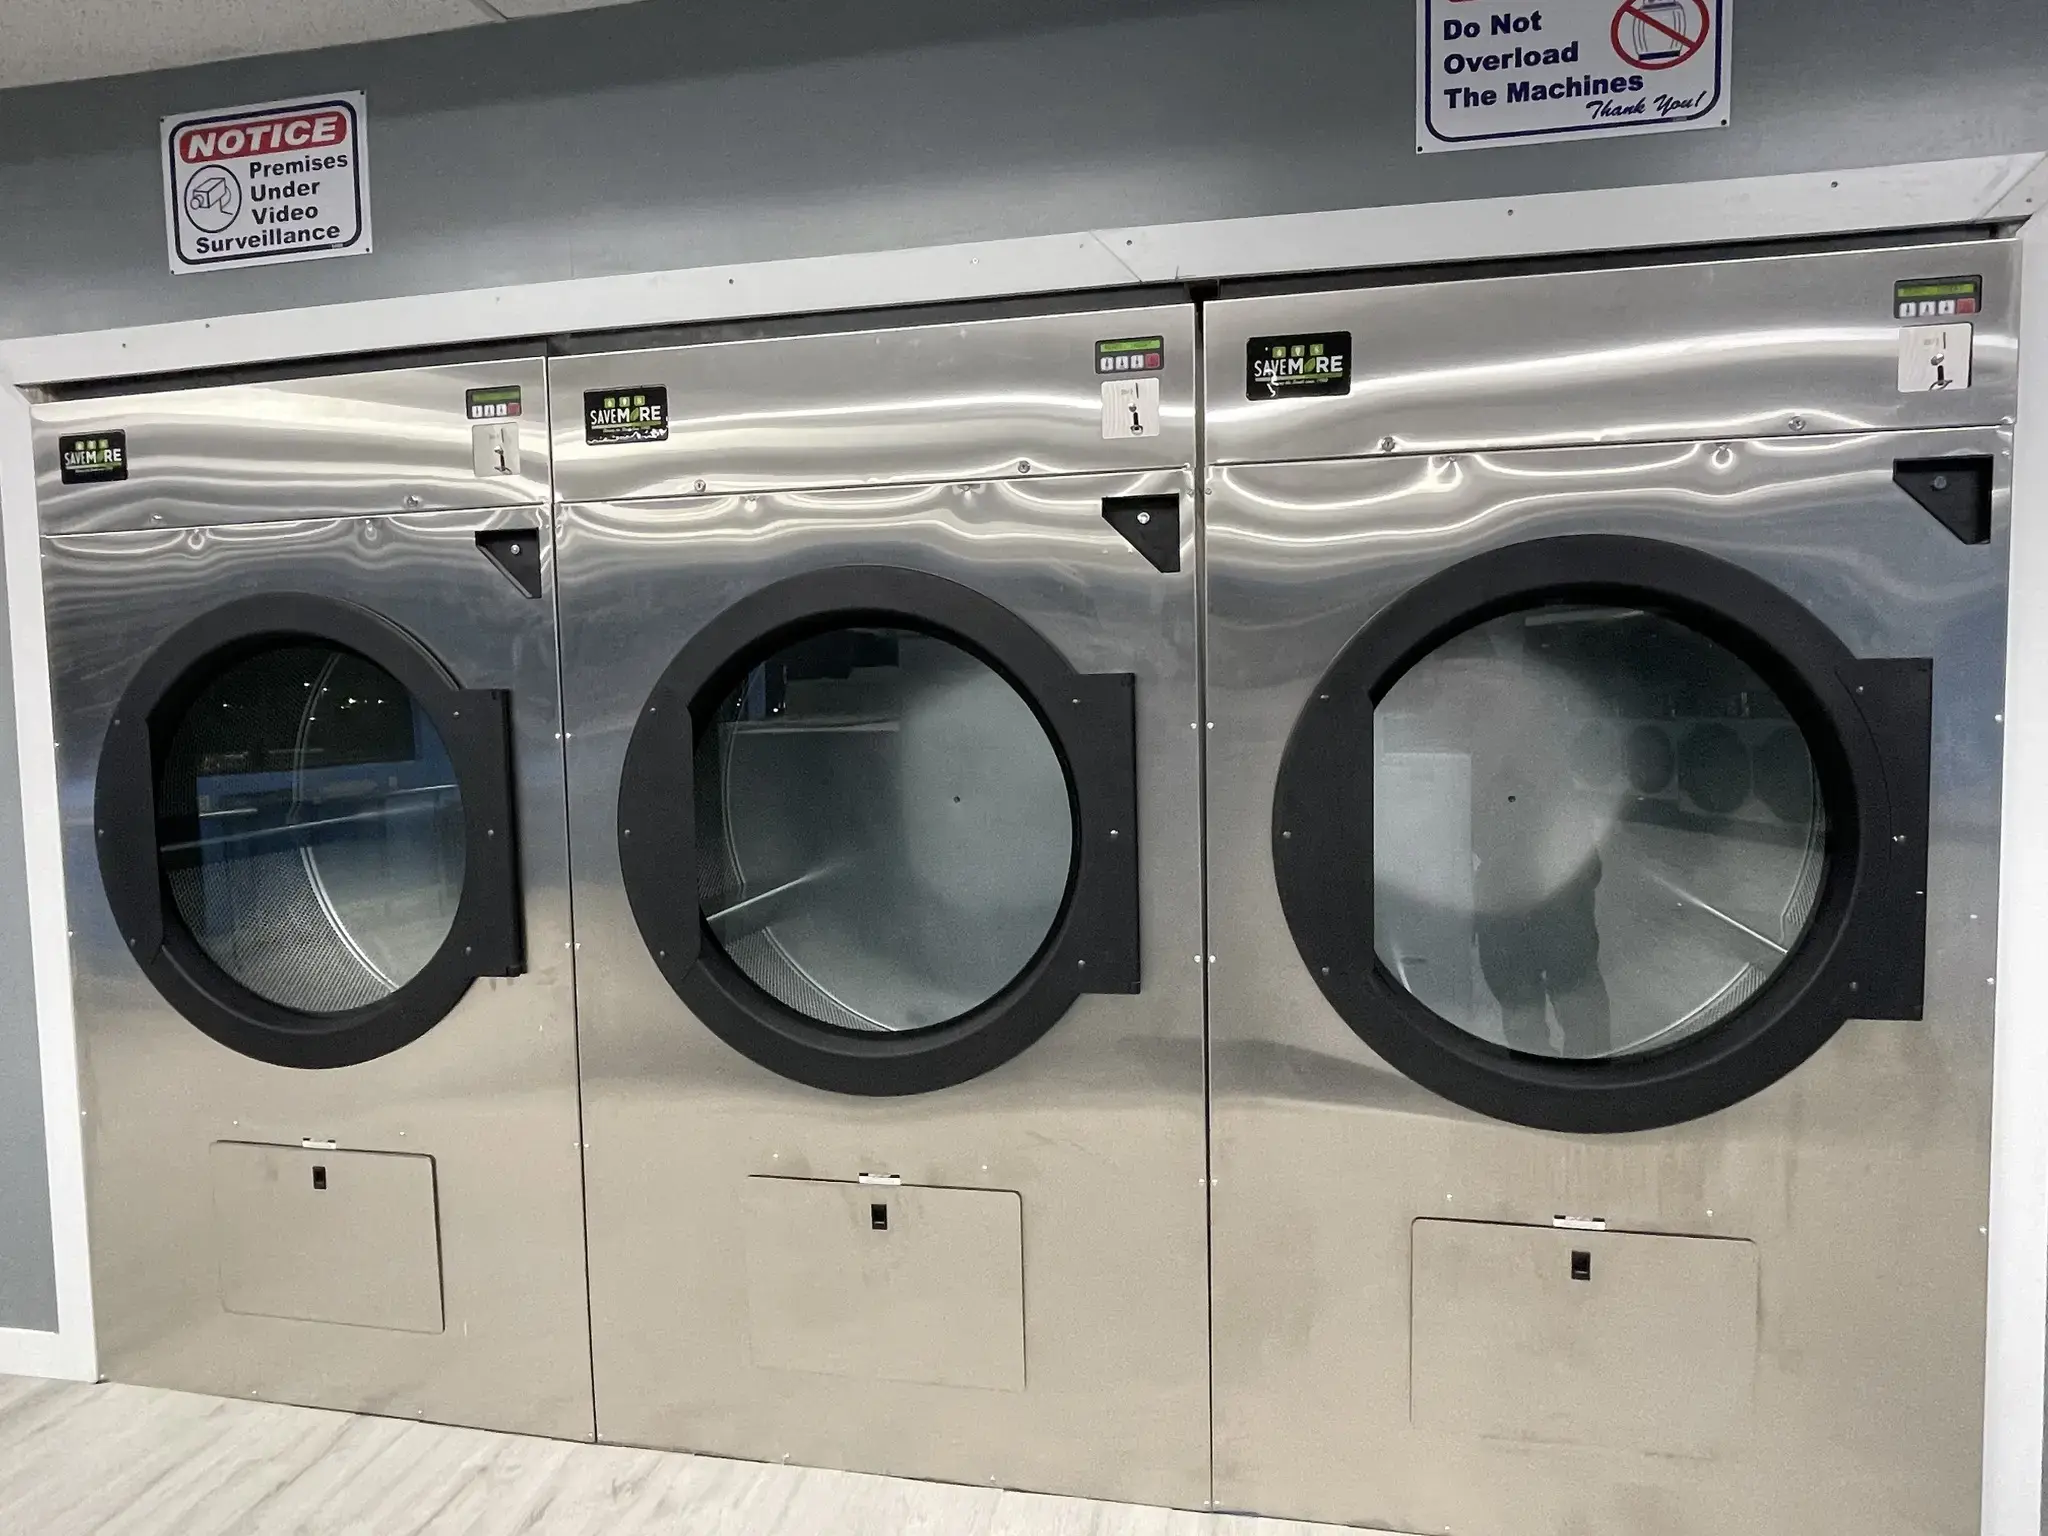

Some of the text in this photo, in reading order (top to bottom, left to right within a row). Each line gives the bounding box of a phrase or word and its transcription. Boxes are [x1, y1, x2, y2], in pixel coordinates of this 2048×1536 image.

[1443, 10, 1542, 41] Do Not
[1443, 41, 1579, 75] Overload
[1443, 74, 1644, 109] The Machines
[1586, 90, 1707, 119] Thank You!
[188, 116, 338, 159] NOTICE
[249, 154, 348, 179] Premises
[250, 181, 320, 202] Under
[252, 205, 318, 225] Video
[196, 225, 340, 254] Surveillance
